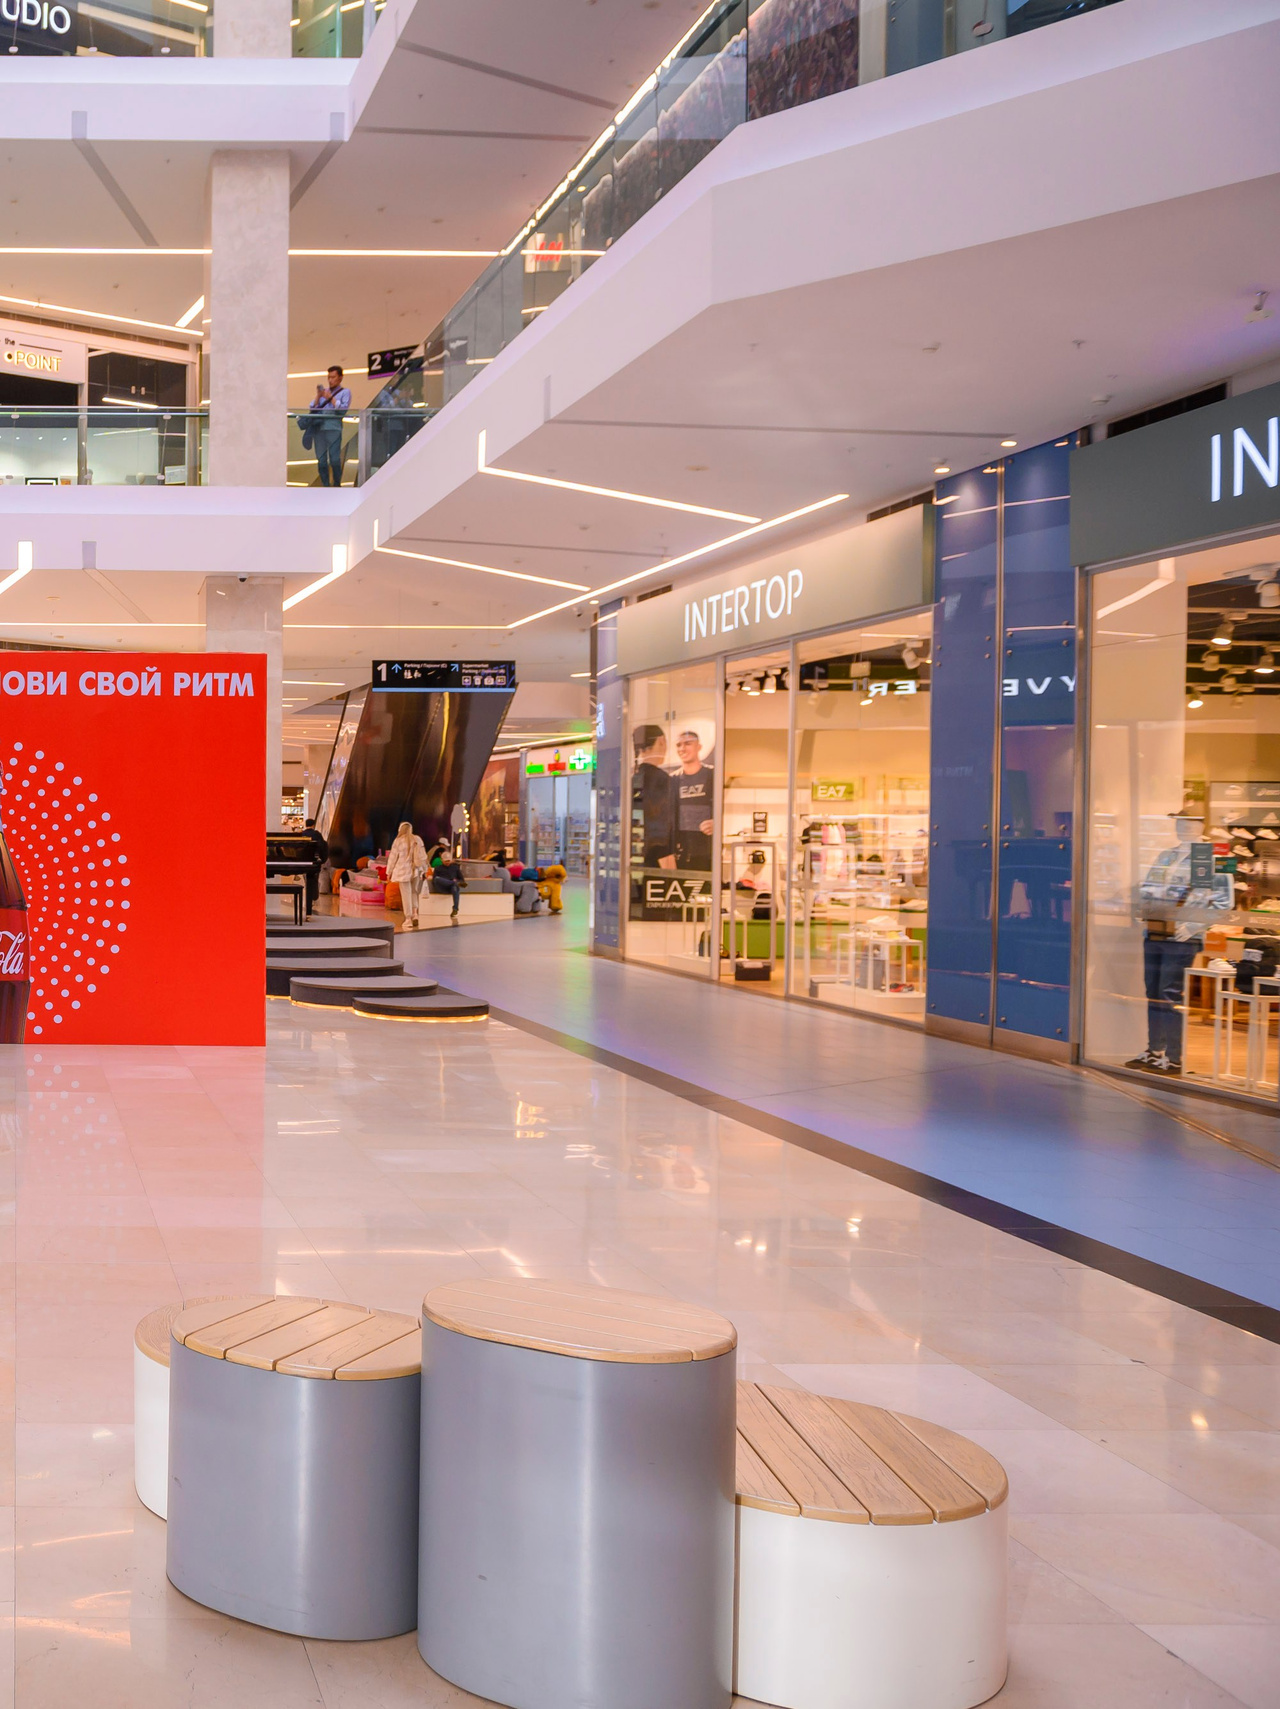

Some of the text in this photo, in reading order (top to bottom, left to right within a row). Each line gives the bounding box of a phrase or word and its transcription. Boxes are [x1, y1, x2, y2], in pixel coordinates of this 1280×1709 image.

[4, 338, 15, 346] the
[14, 350, 62, 372] POINT
[371, 354, 382, 370] 2
[1211, 416, 1279, 502] IN
[684, 568, 803, 642] INTERTOP
[79, 667, 162, 697] СВОЙ
[174, 671, 254, 697] РИТМ
[377, 663, 387, 682] 1
[679, 784, 705, 795] EA7
[817, 786, 846, 798] EA7
[646, 880, 705, 902] EA7
